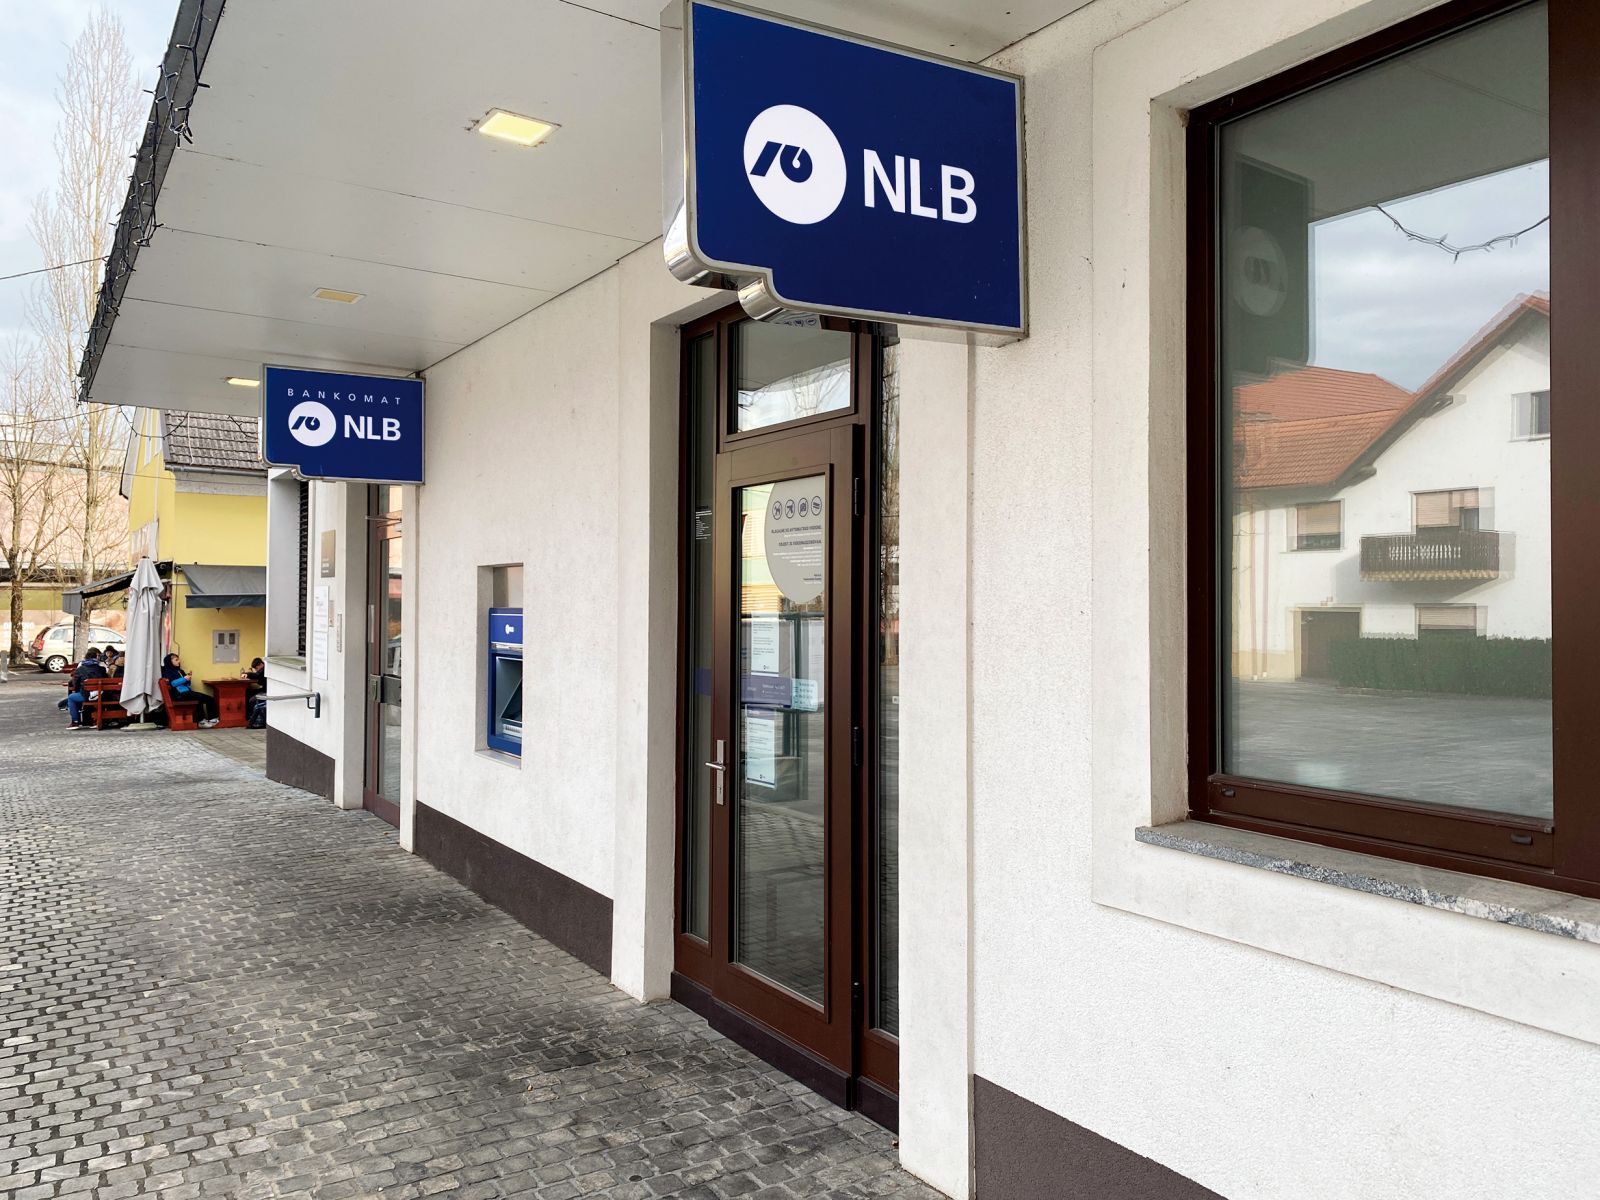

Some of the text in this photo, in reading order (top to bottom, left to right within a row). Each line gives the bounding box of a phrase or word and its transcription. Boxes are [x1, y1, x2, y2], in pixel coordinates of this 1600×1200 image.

[863, 148, 977, 224] NLB
[287, 388, 401, 405] BANKOMAT
[344, 414, 401, 441] NLB
